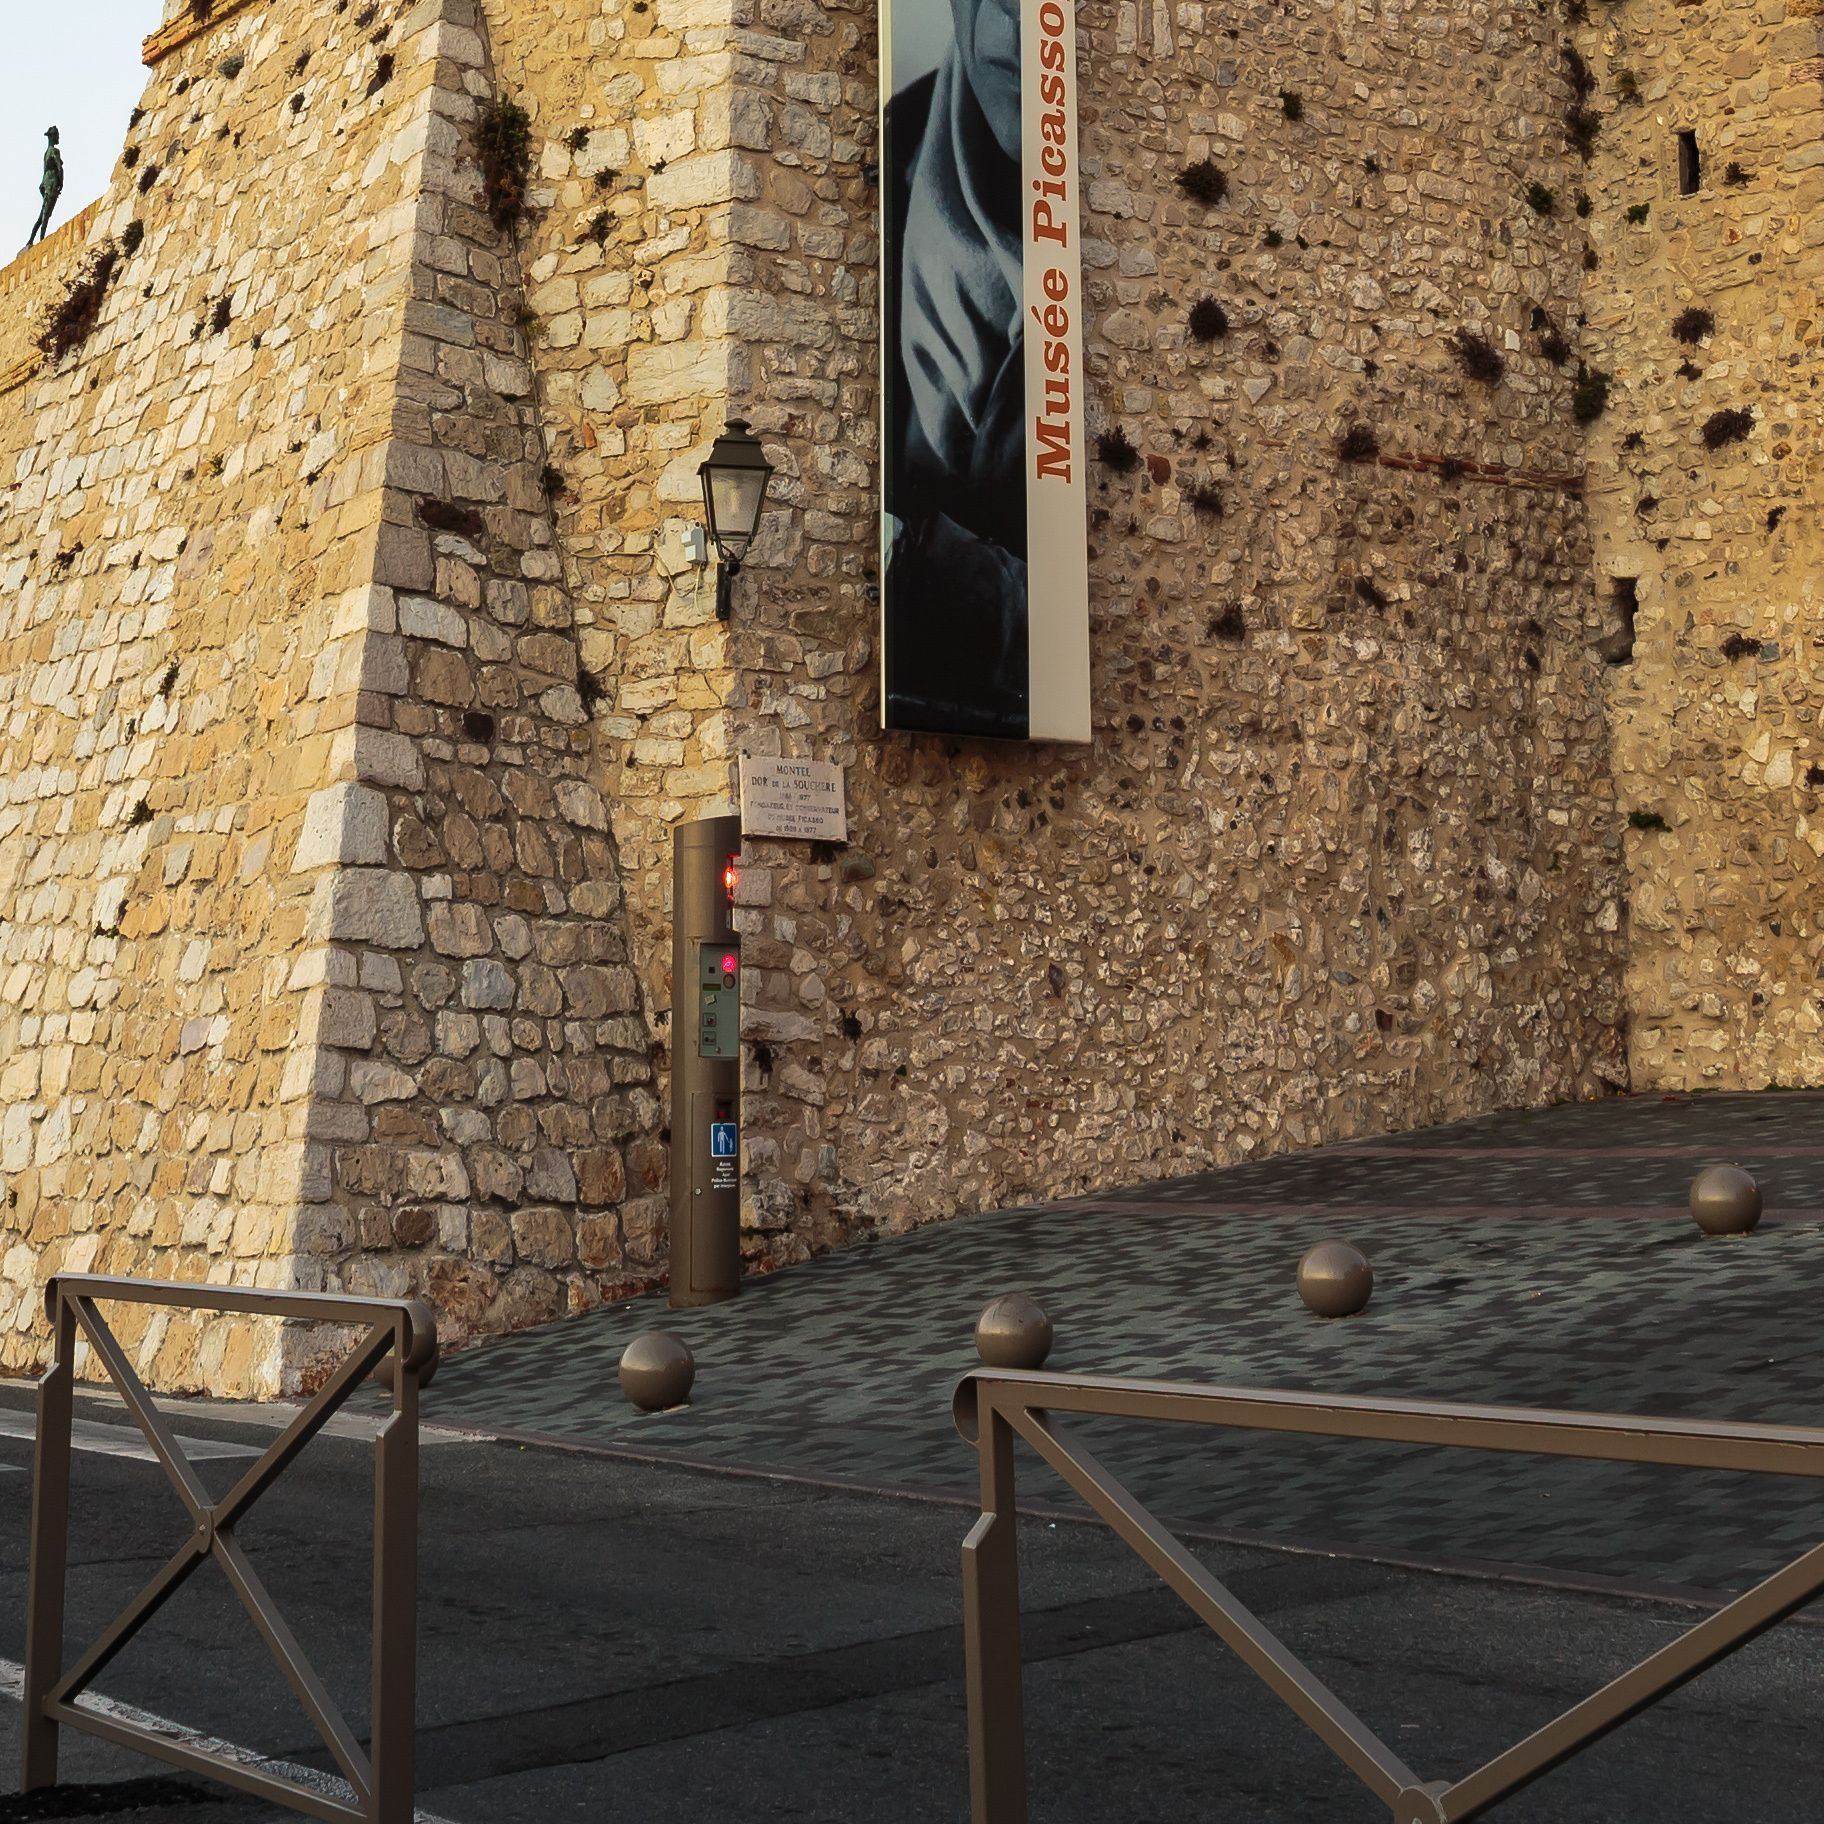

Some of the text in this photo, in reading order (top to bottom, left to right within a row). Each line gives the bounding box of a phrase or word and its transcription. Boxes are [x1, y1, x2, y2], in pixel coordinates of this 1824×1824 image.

[1030, 268, 1073, 484] Musée
[776, 765, 811, 776] MONTEL
[752, 777, 768, 787] DOR
